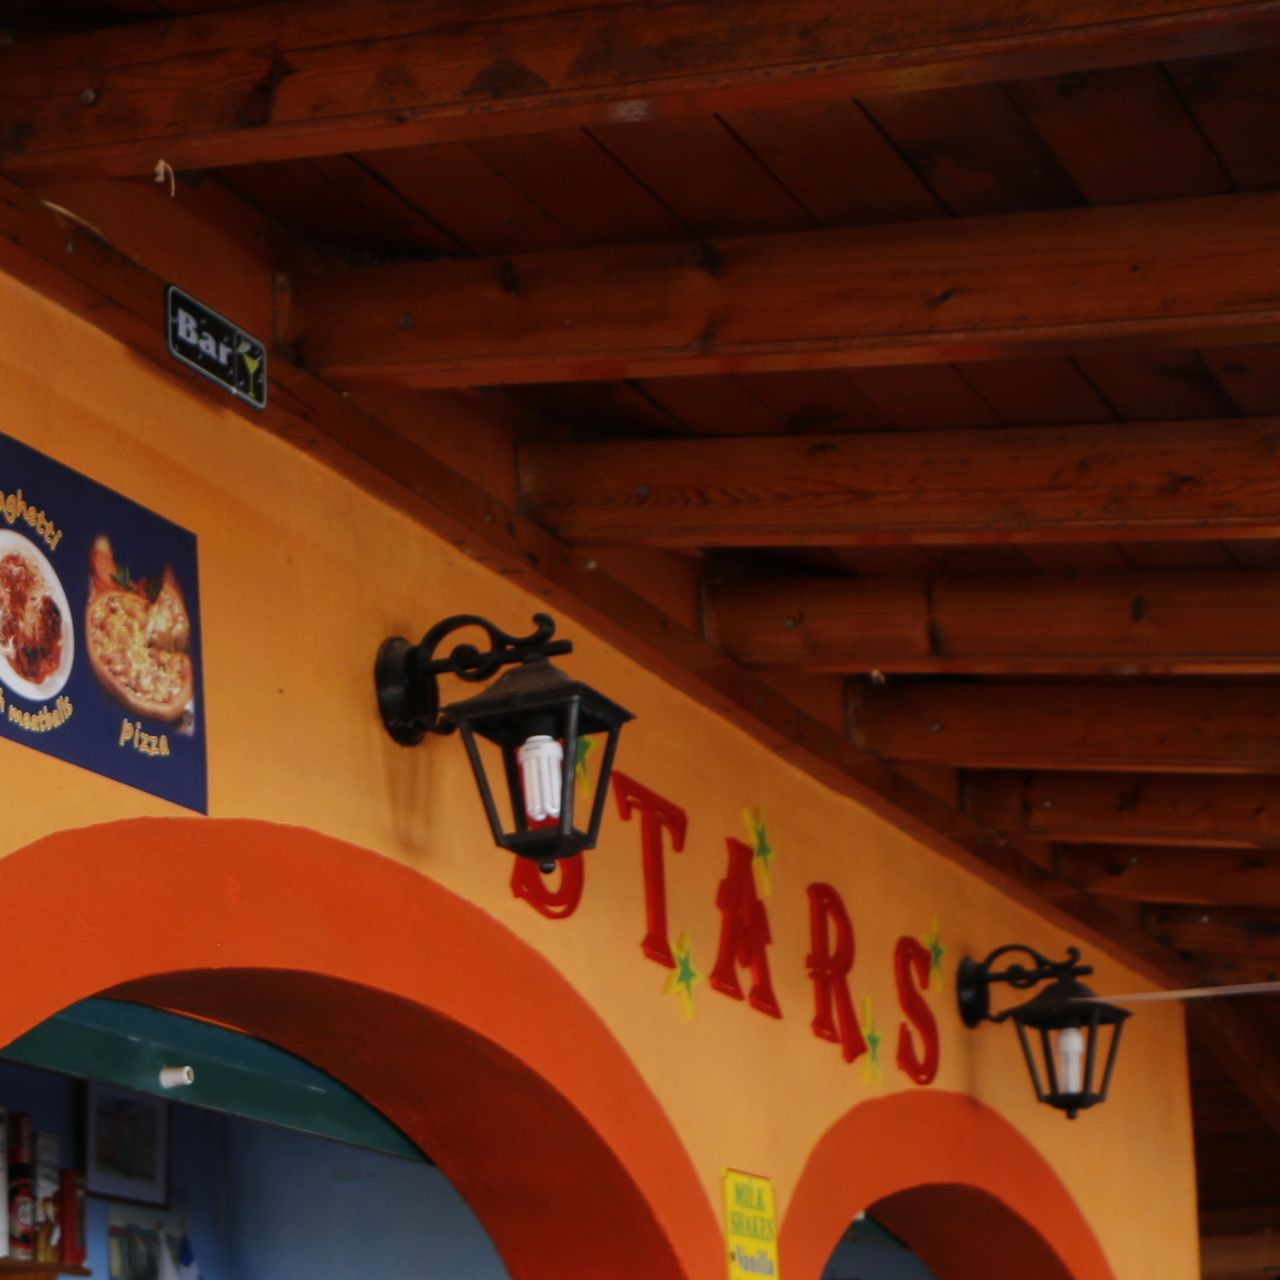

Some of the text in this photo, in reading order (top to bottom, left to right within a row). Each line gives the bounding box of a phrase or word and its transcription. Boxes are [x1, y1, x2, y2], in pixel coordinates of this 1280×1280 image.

[176, 308, 232, 365] Bar
[8, 697, 73, 733] meatballs
[119, 719, 170, 756] pizza
